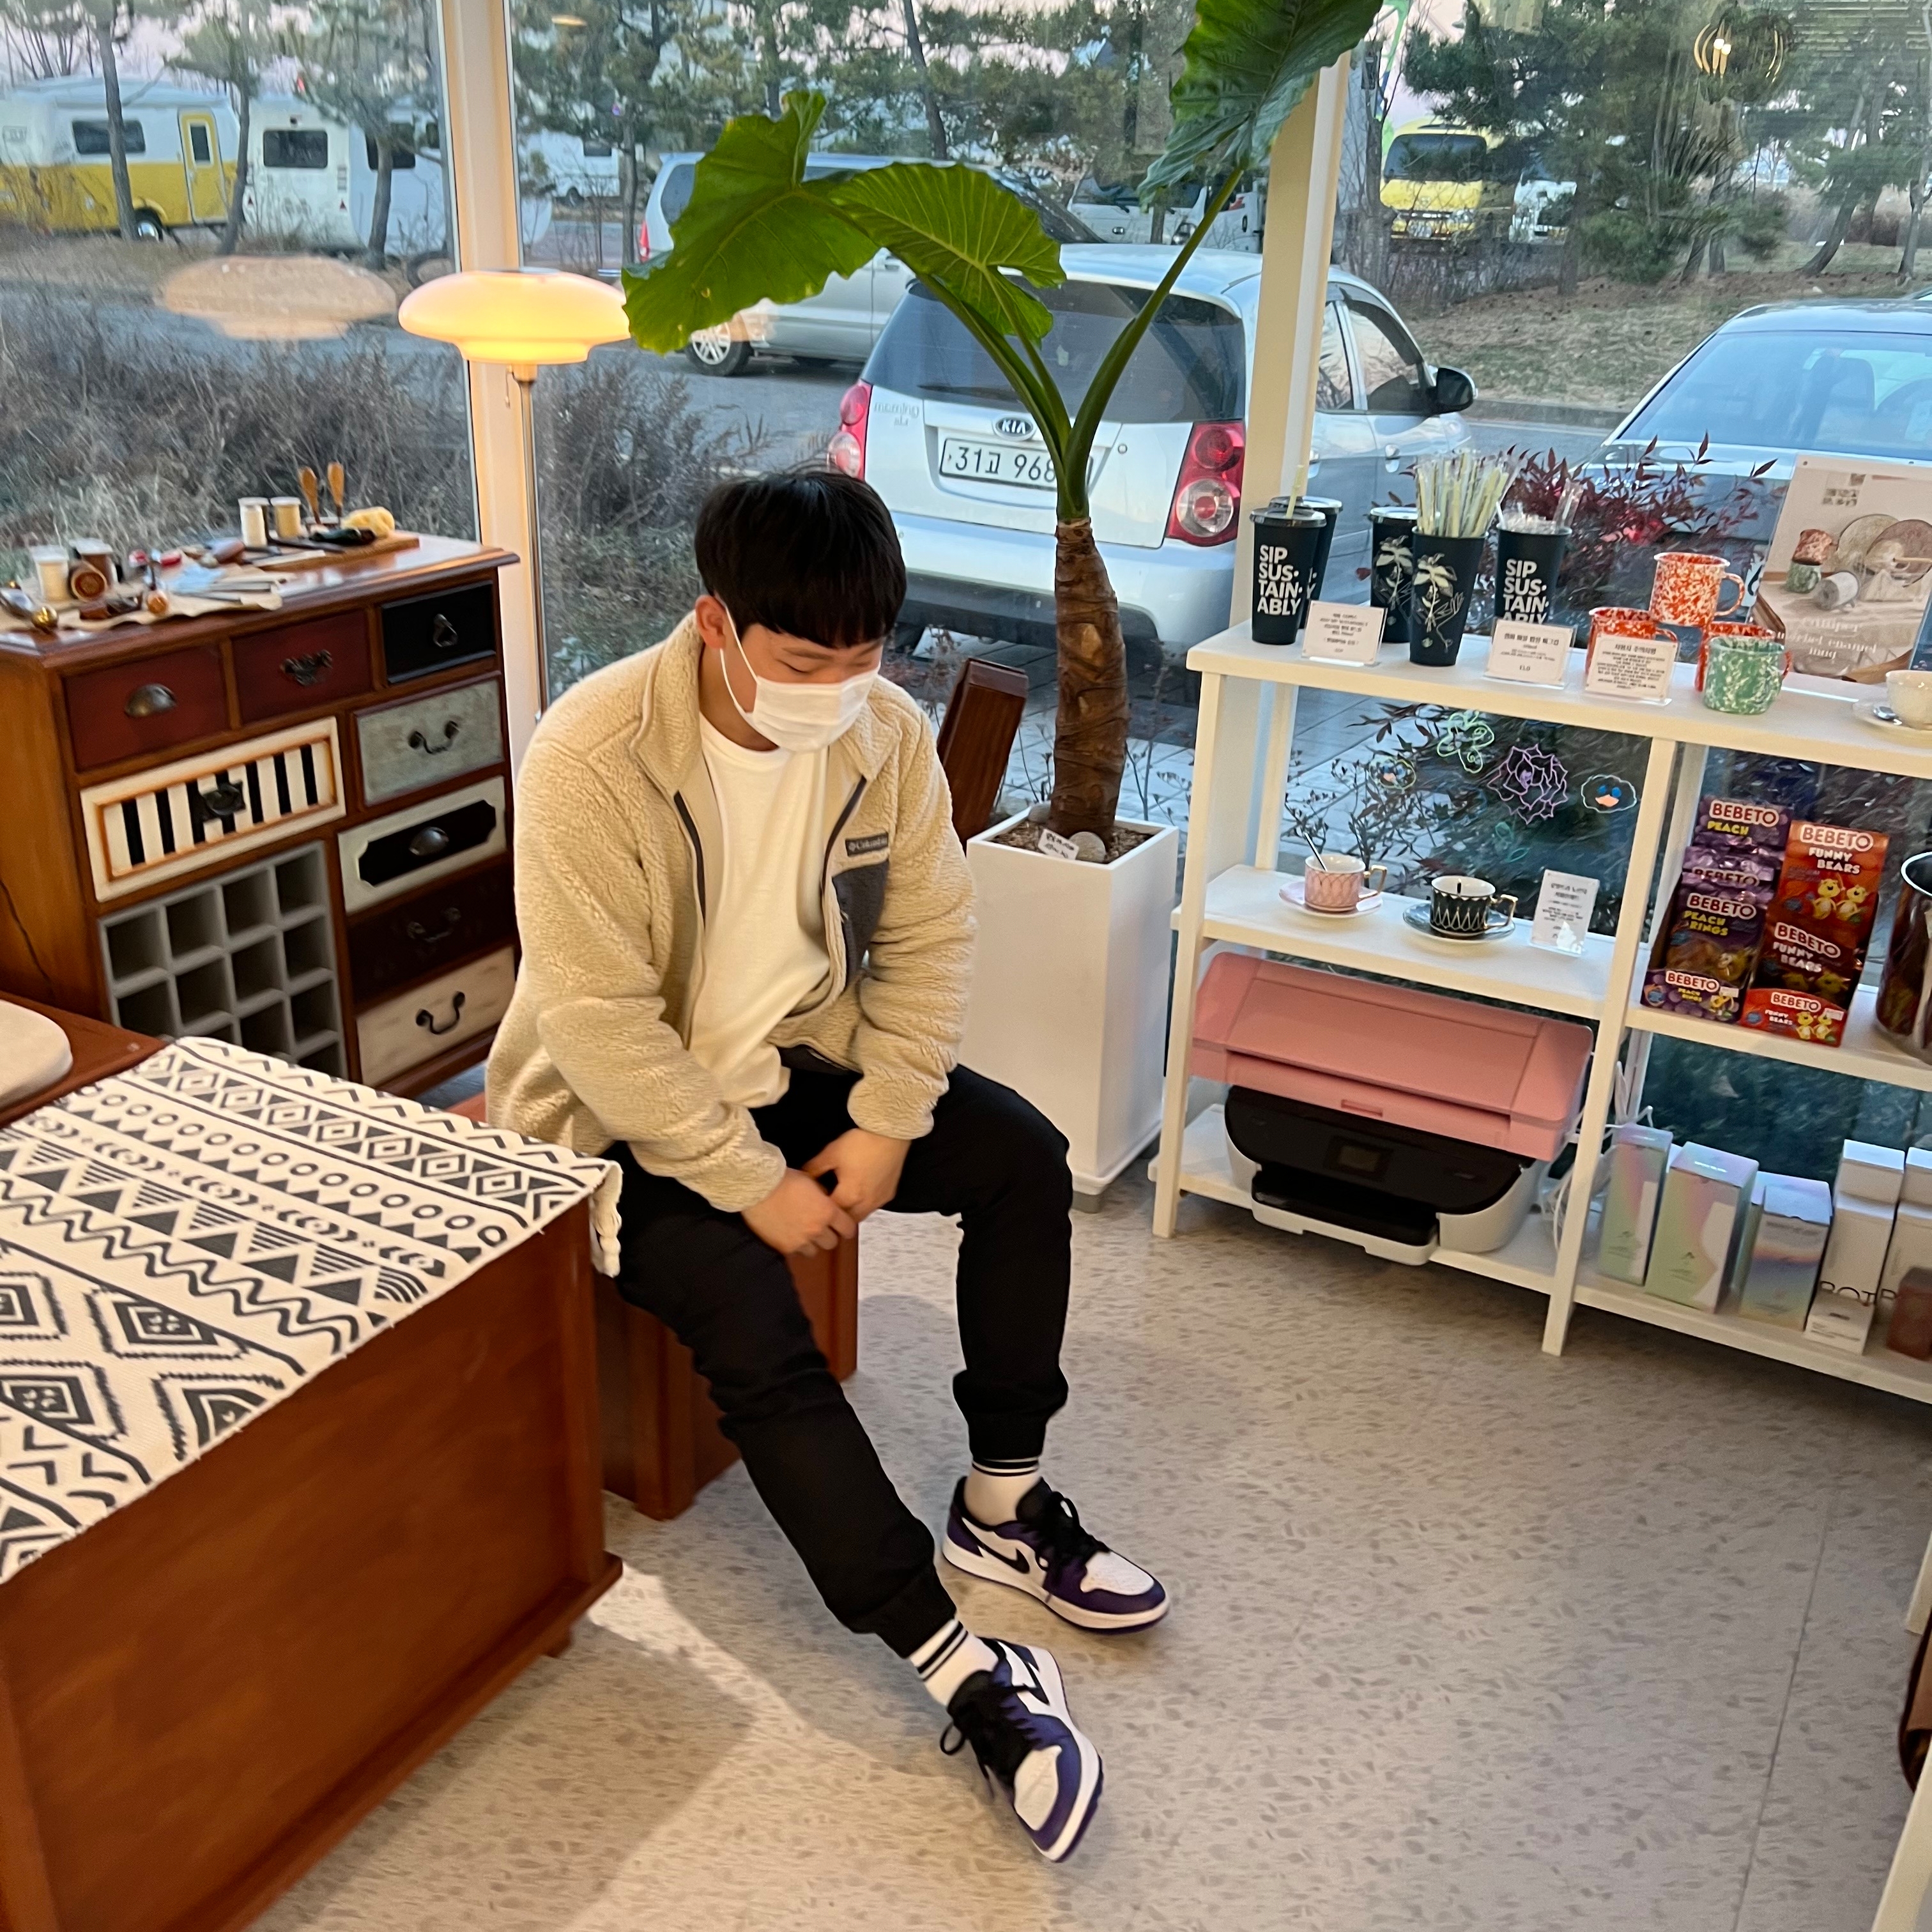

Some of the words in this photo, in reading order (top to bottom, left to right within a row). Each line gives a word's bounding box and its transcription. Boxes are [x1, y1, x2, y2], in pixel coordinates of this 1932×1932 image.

[1002, 419, 1027, 434] KIA
[955, 447, 1001, 474] 31고
[1014, 454, 1056, 482] 968
[1259, 544, 1288, 564] SIP
[1505, 558, 1537, 578] SIP
[1257, 597, 1301, 615] ABLY
[1711, 801, 1777, 825] BEBETO
[1706, 820, 1749, 836] PEACH
[1802, 826, 1871, 850] BEBETO
[1808, 847, 1853, 862] FUNNY
[1816, 859, 1860, 874] BEARS
[1689, 894, 1754, 918] BEBETO
[1683, 910, 1726, 926] PEACH
[1689, 921, 1728, 936] RINGS
[1777, 924, 1839, 956] BEBETO
[1773, 941, 1814, 960] FUNNY
[1781, 954, 1822, 972] BEARS
[1667, 972, 1718, 991] BEBETO
[1772, 993, 1820, 1011] BEBETO
